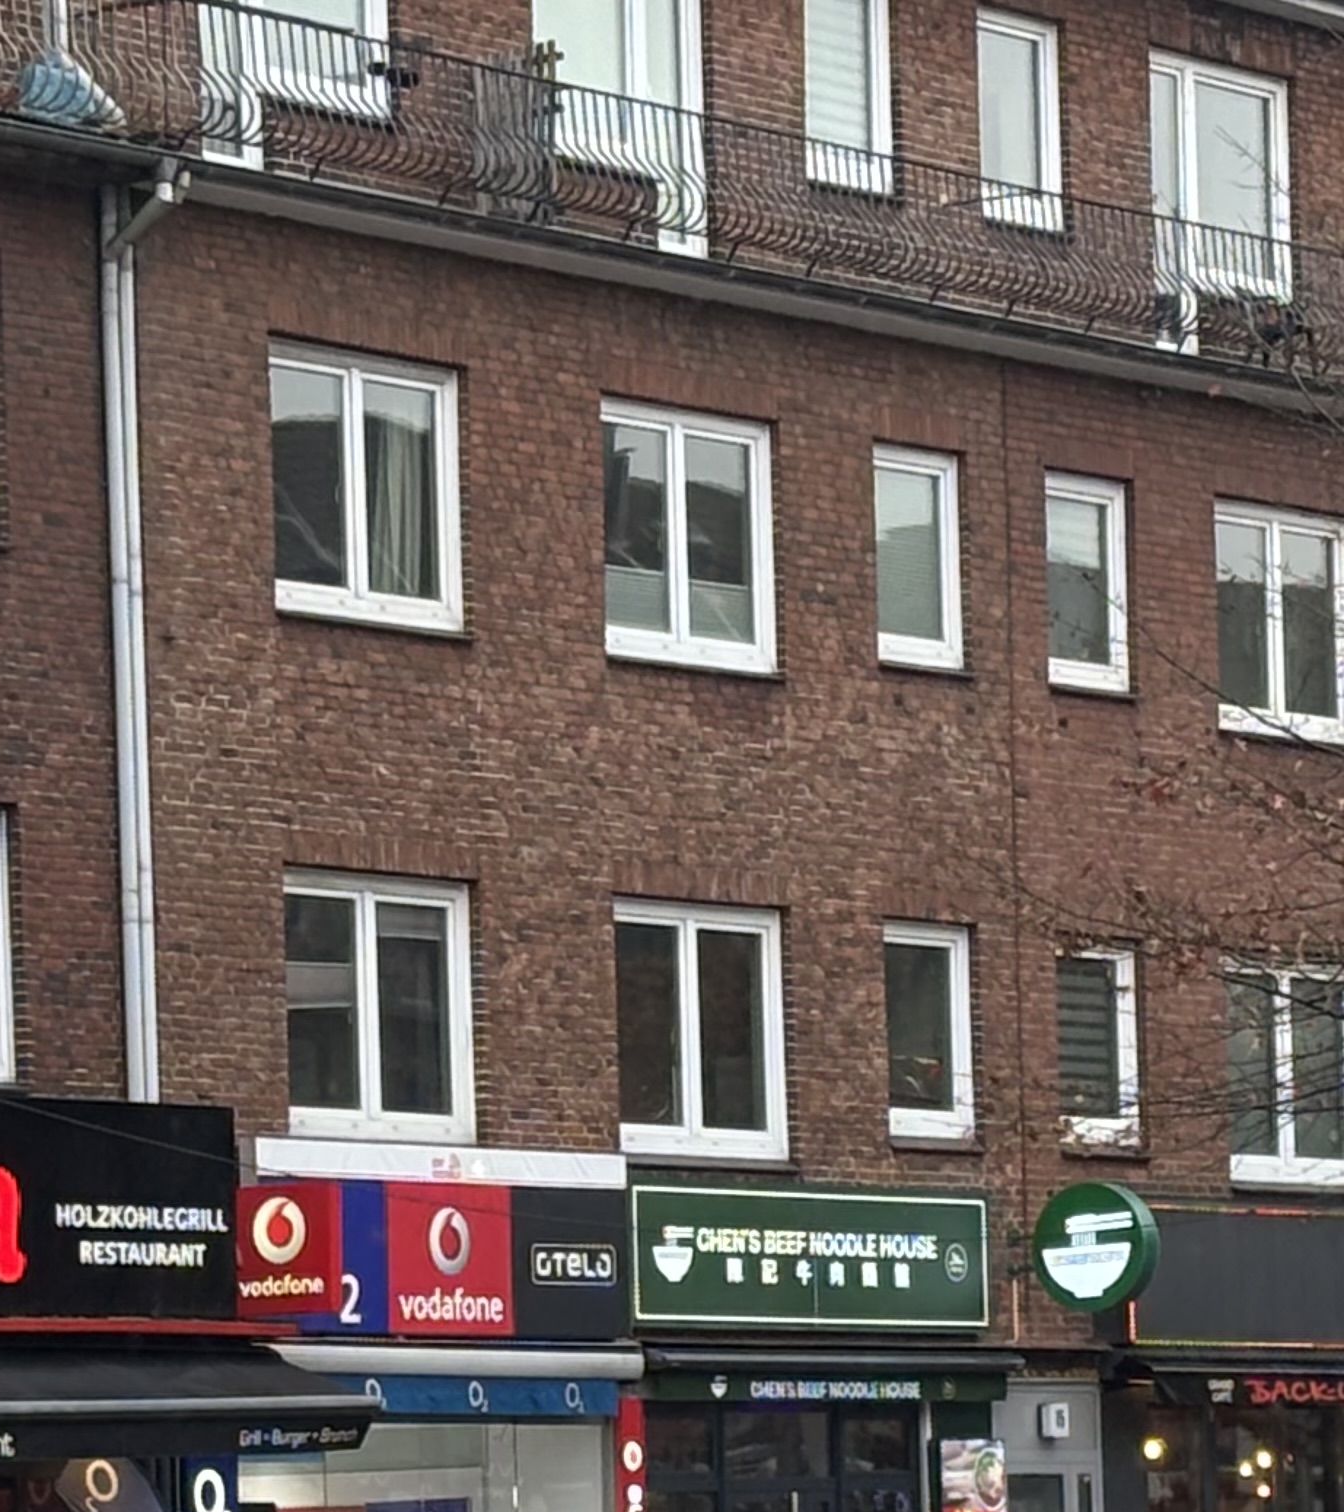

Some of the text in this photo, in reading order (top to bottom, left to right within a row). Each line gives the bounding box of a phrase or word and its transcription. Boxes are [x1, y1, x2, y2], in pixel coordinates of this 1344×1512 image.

[55, 1202, 229, 1234] HOLZKOHLEGRILL
[78, 1241, 208, 1269] RESTAURANT
[696, 1227, 939, 1259] CHEN'S BEEF NOODLE HOUSE
[238, 1272, 324, 1298] vodafone
[398, 1287, 505, 1323] vodafone
